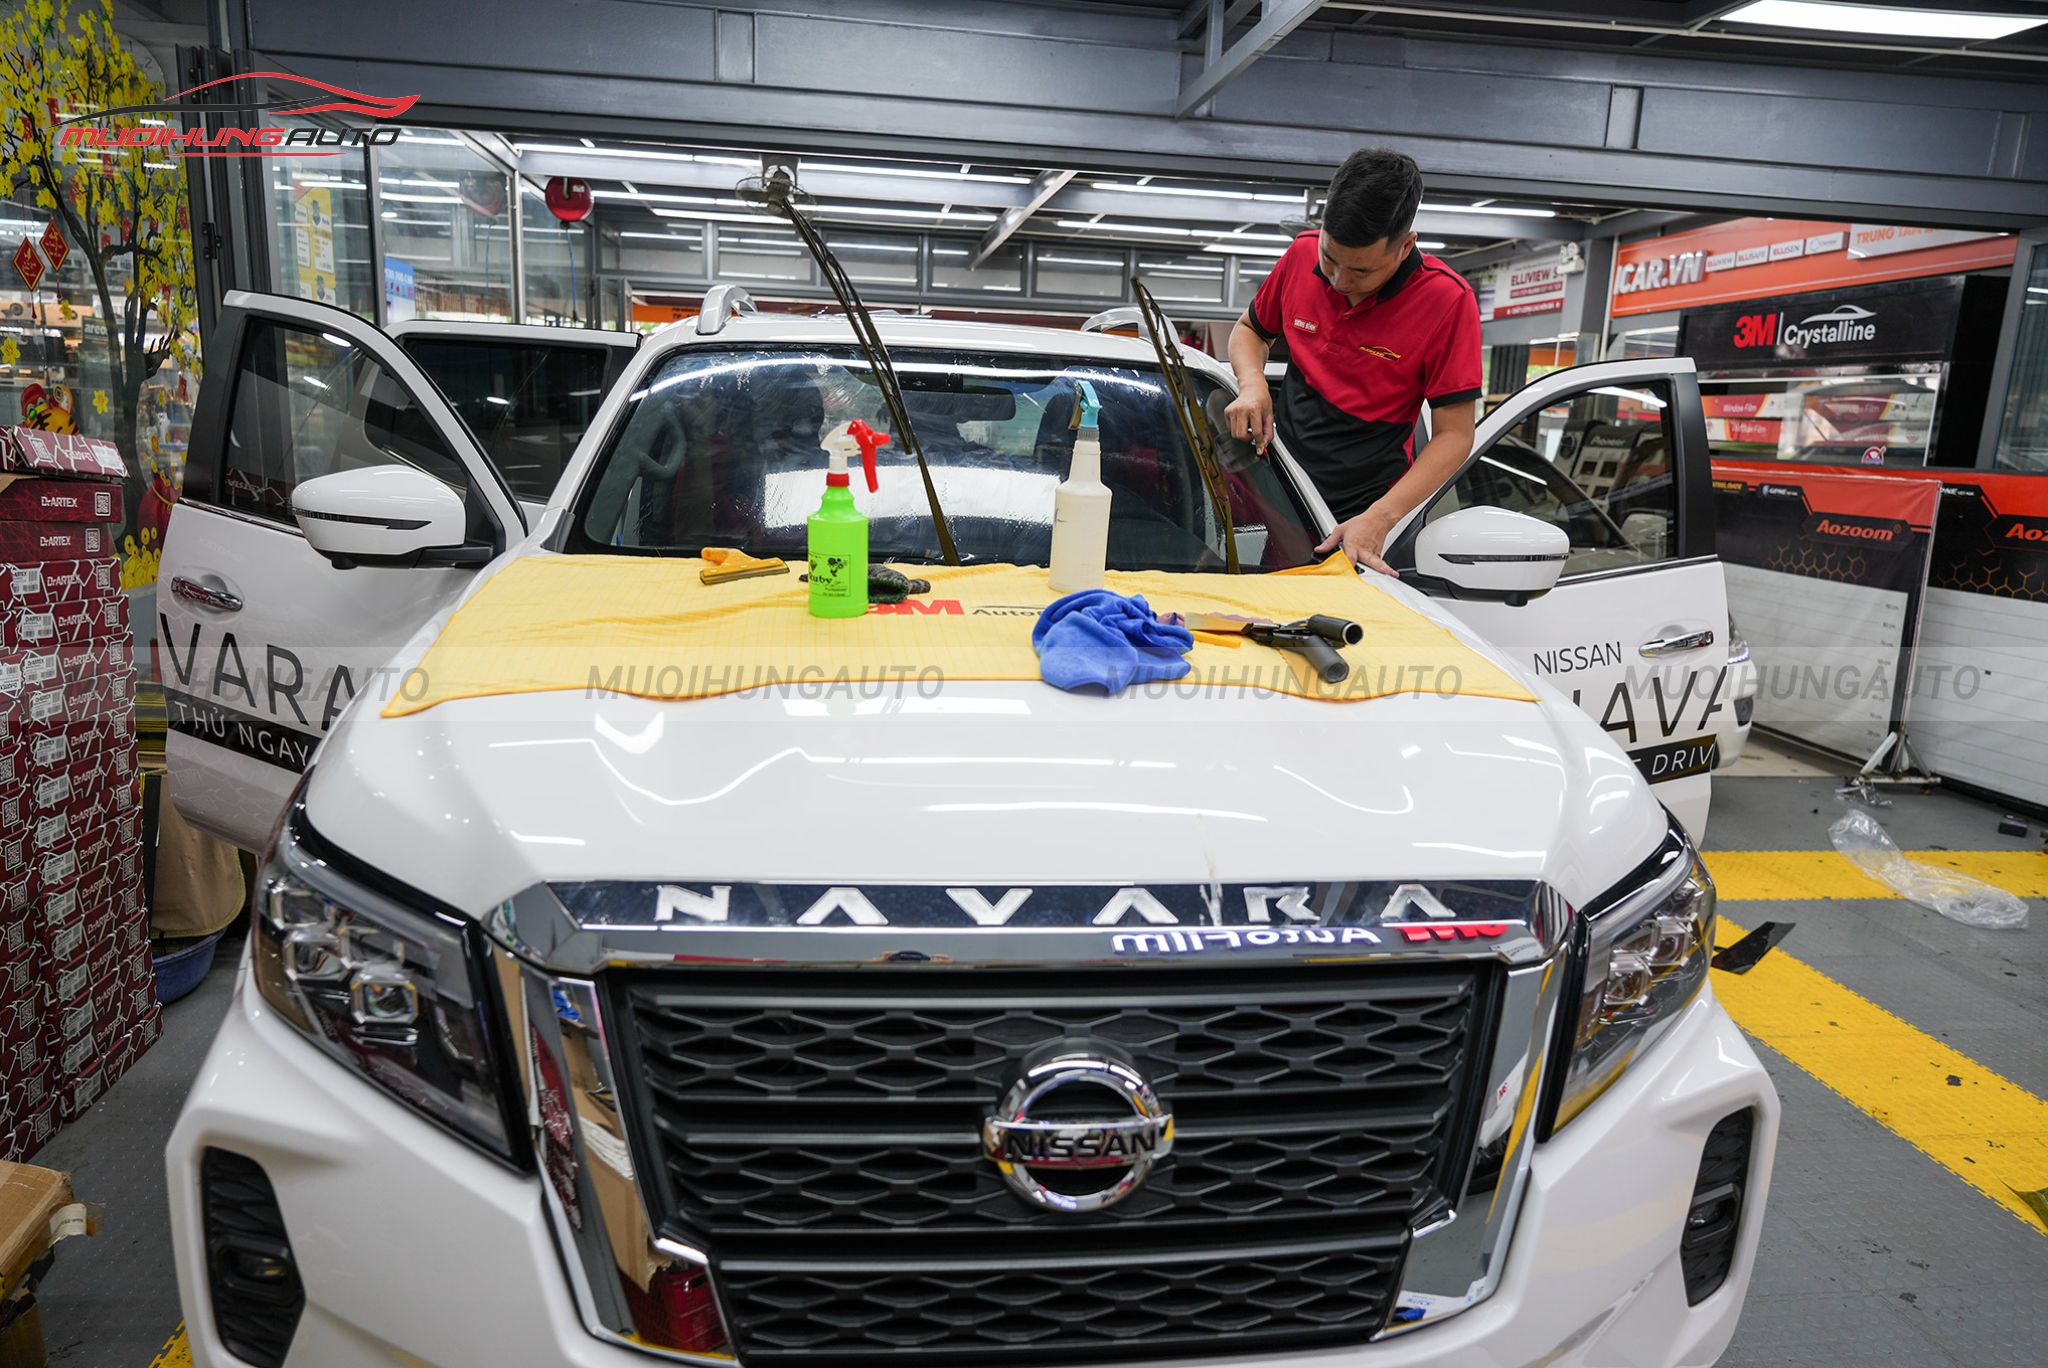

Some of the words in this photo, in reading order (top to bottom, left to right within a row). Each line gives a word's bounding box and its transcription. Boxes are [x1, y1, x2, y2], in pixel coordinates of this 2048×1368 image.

[1856, 225, 1895, 245] TRUNG
[1511, 270, 1550, 287] ELLIVIEW
[84, 323, 107, 335] areo
[1733, 313, 1778, 349] 3M
[1784, 321, 1876, 349] Crystalline
[41, 496, 78, 508] DrARTEX
[1816, 519, 1894, 542] Aozoom
[40, 536, 71, 547] DrARTEX
[47, 574, 82, 587] DrARTEX
[58, 613, 91, 627] DrARTEX
[972, 608, 1042, 617] Auto
[1534, 641, 1622, 676] NISSAN
[238, 726, 309, 767] NGAY
[655, 884, 1457, 927] NAVARA
[1005, 1131, 1157, 1163] NISSAN
